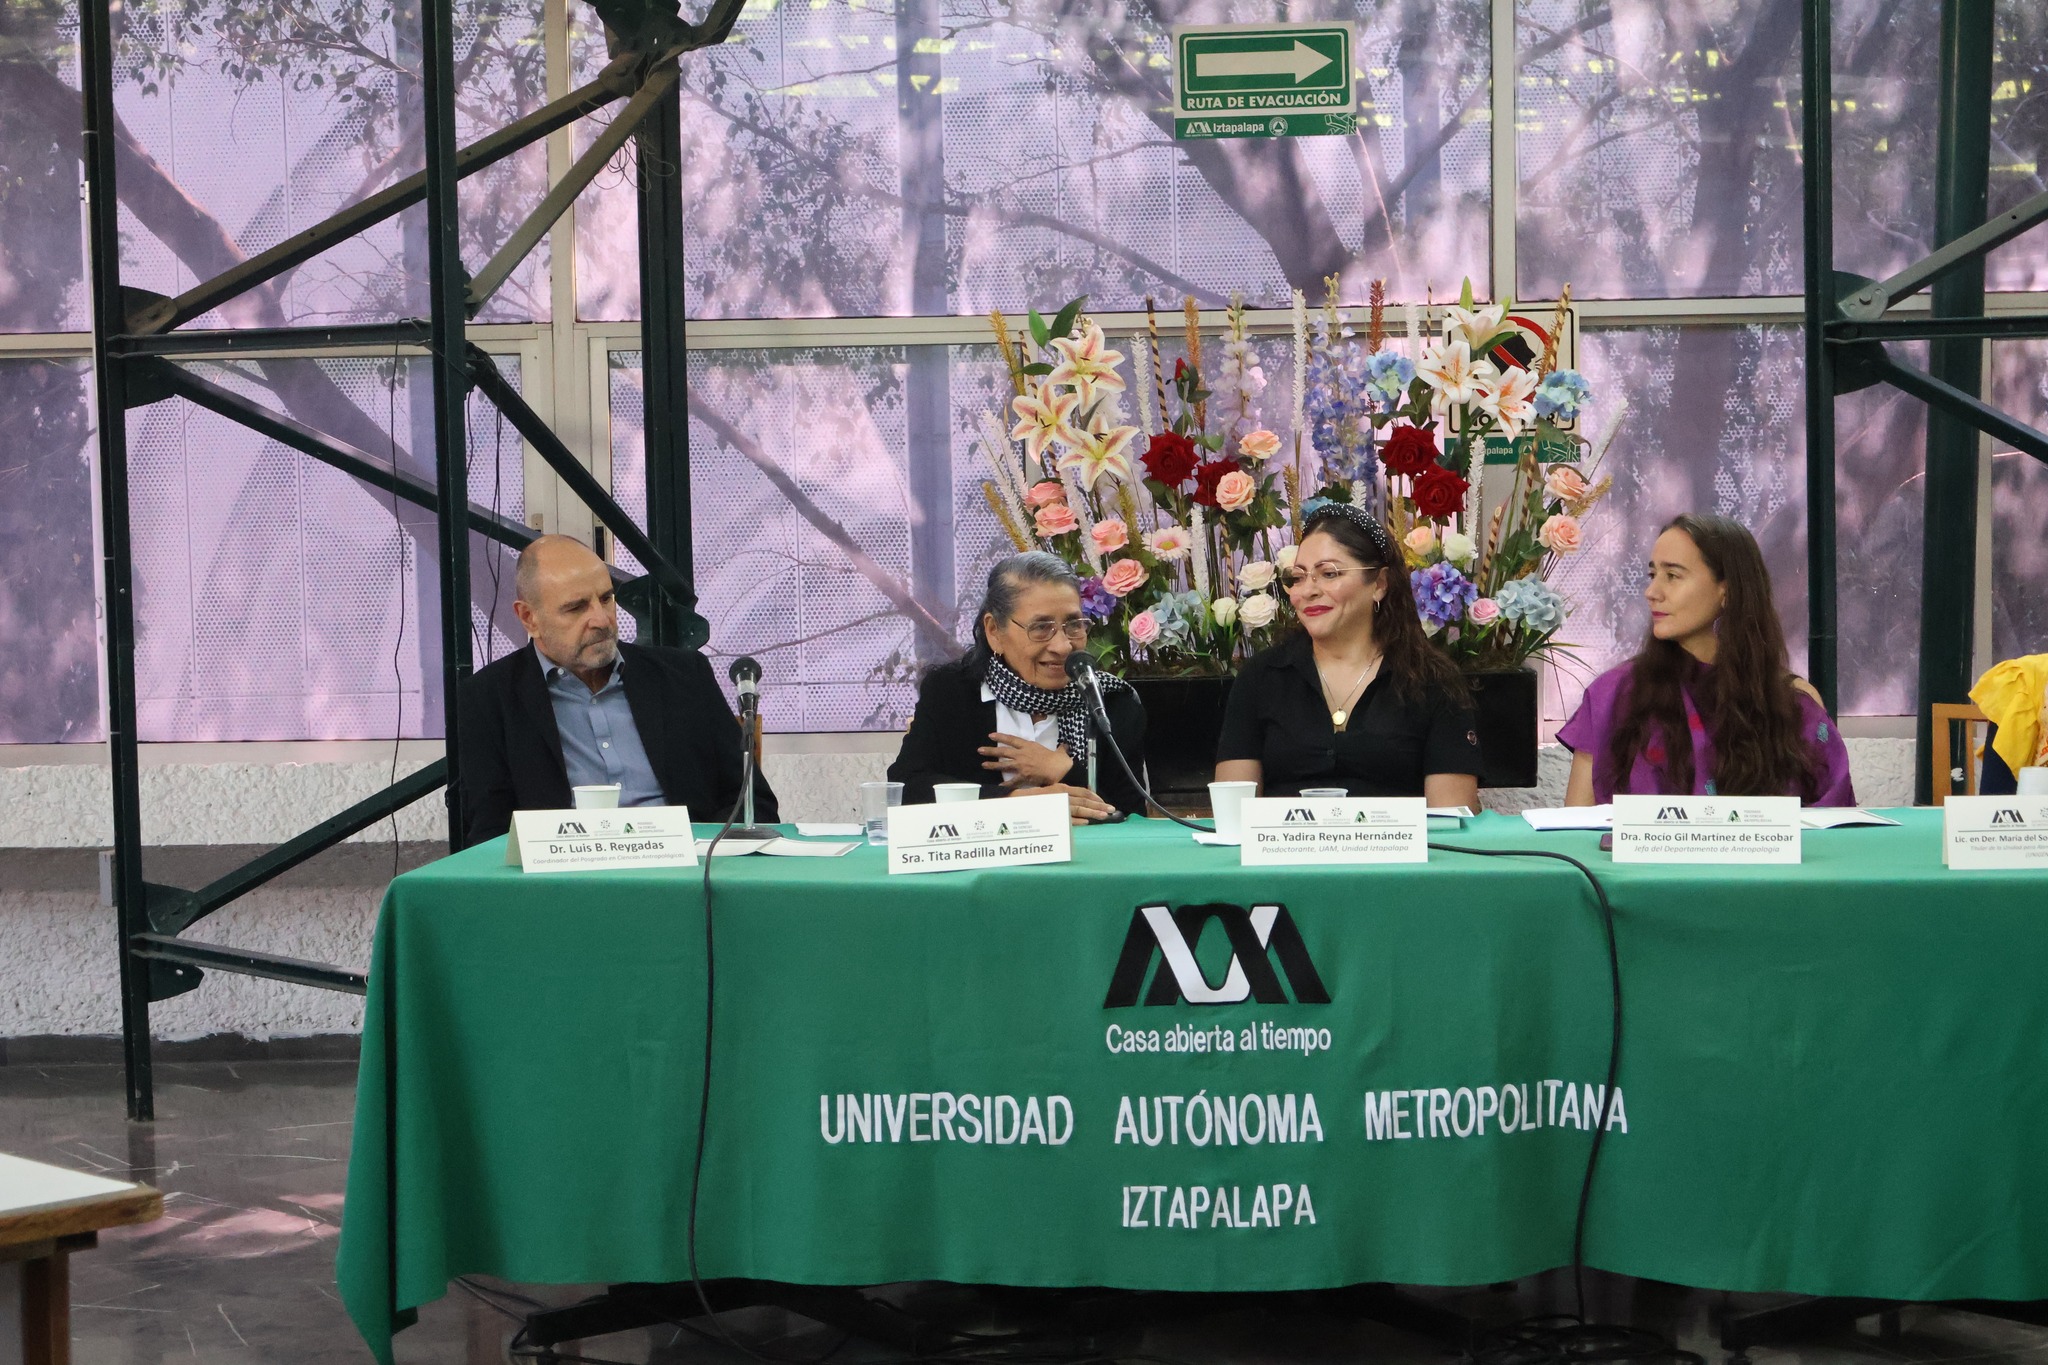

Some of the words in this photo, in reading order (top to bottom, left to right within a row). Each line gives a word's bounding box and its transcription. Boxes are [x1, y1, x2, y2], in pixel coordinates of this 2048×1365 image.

[1186, 97, 1223, 109] RUTA
[1227, 96, 1245, 107] DE
[1249, 90, 1341, 107] EVACUACIÓN
[1213, 122, 1265, 134] Iztapalapa
[1257, 833, 1280, 842] Dra.
[1282, 831, 1316, 842] Yadira
[1319, 832, 1352, 844] Reyna
[1354, 831, 1413, 841] Hernández
[1620, 832, 1642, 841] Dra.
[1644, 832, 1672, 842] Rocío
[1674, 832, 1689, 842] Gil
[1691, 832, 1736, 842] Martínez
[1739, 833, 1752, 842] de
[1754, 833, 1794, 842] Escobar
[1981, 835, 1997, 843] Der.
[549, 844, 566, 854] Dr.
[570, 843, 592, 853] Luis
[595, 842, 607, 852] B.
[610, 840, 665, 853] Reygadas
[902, 853, 925, 864] Sra.
[928, 850, 951, 862] Tita
[954, 846, 995, 860] Radilla
[999, 843, 1054, 856] Martínez
[1261, 846, 1317, 854] Posdoctorante,
[1319, 845, 1340, 853] UAM,
[1341, 845, 1369, 853] Unidad
[1369, 844, 1409, 853] Iztapalapa
[1634, 845, 1649, 853] Jefa
[1651, 845, 1663, 853] del
[1664, 846, 1718, 854] Departamento
[532, 857, 569, 865] Coordinador
[580, 855, 608, 863] Posgrado
[1106, 1023, 1160, 1053] Casa
[1164, 1023, 1235, 1052] abierta
[1240, 1021, 1257, 1051] al
[1261, 1021, 1332, 1056] tiempo
[820, 1091, 1074, 1146] UNIVERSIDAD
[1114, 1089, 1324, 1147] AUTÓNOMA
[1365, 1079, 1628, 1140] METROPOLITANA
[1122, 1183, 1317, 1229] IZTAPALAPA
